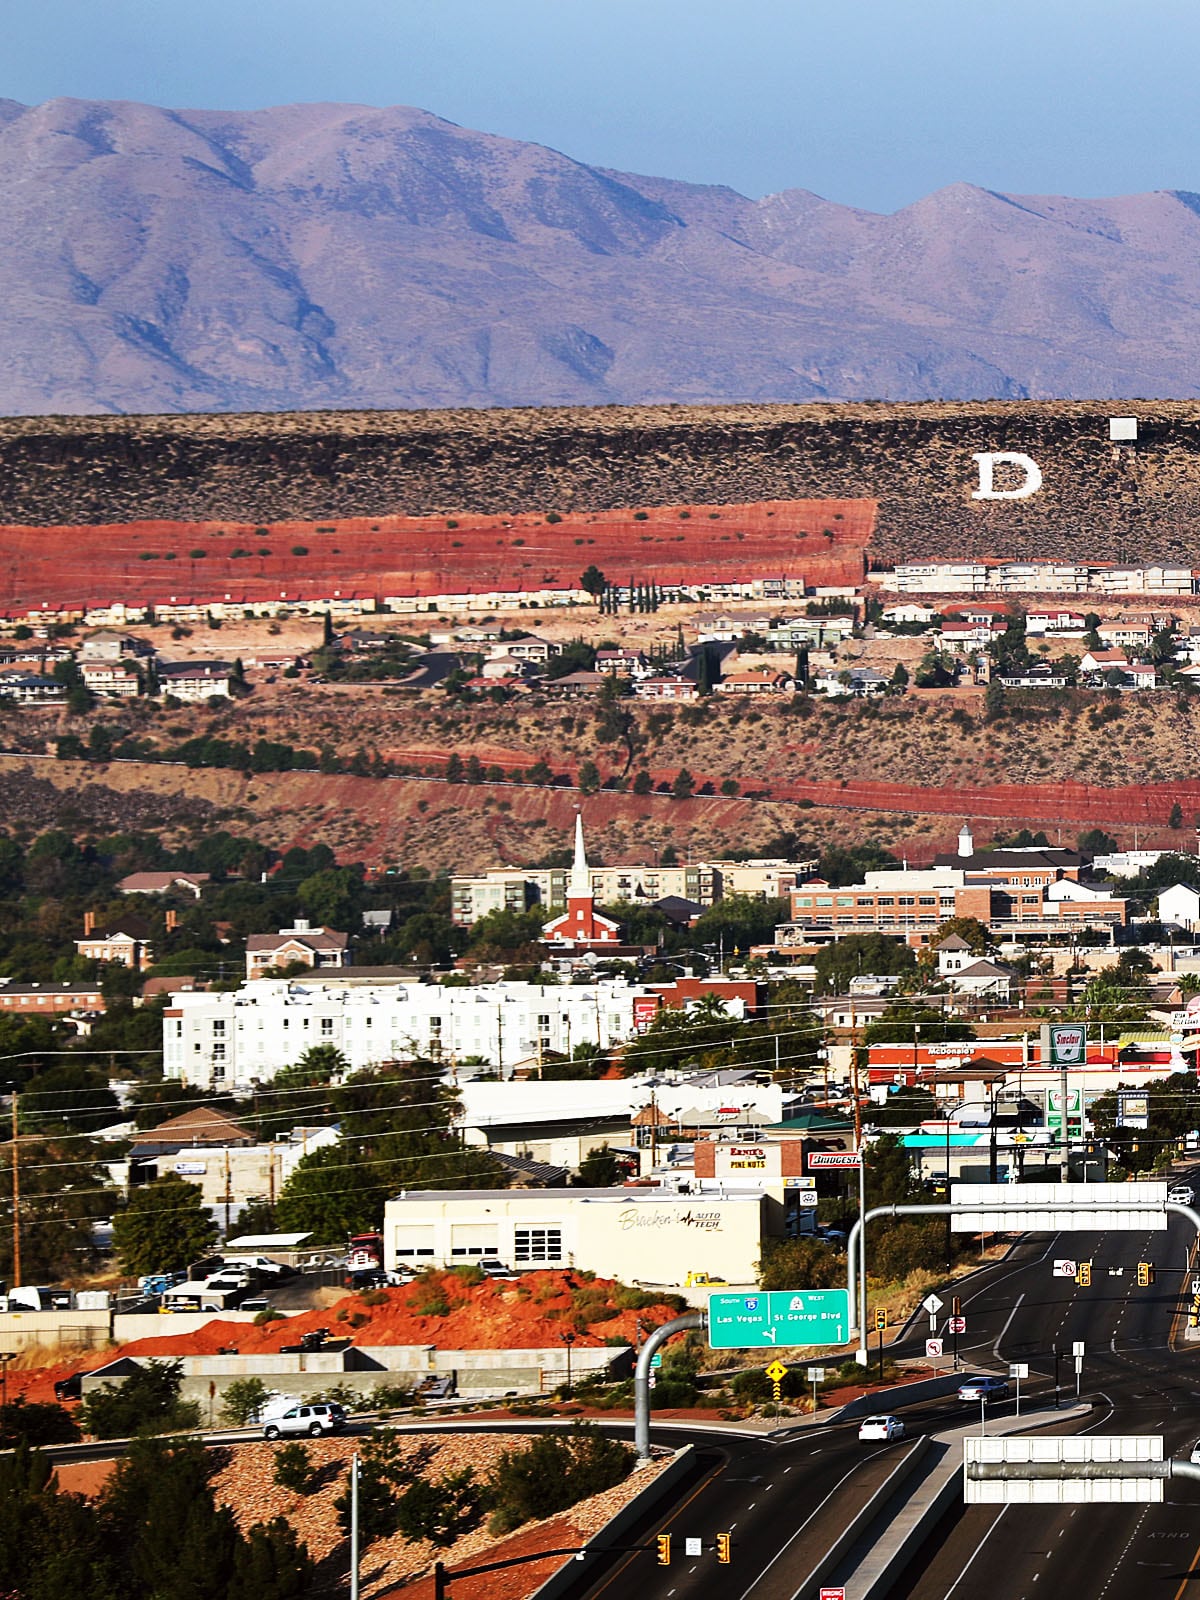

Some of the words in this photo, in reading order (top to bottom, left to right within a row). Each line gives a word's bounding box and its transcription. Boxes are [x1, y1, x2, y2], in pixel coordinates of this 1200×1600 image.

[971, 451, 1043, 501] D
[1056, 1033, 1080, 1045] Sinclair
[928, 1047, 975, 1055] McDonald's
[730, 1160, 745, 1169] PINE
[748, 1160, 765, 1168] NUTS
[747, 1301, 756, 1310] 15
[737, 1315, 763, 1324] Vegas
[774, 1313, 784, 1321] St
[788, 1312, 818, 1321] George
[821, 1312, 841, 1320] Blvd
[1147, 1531, 1191, 1539] ONLY
